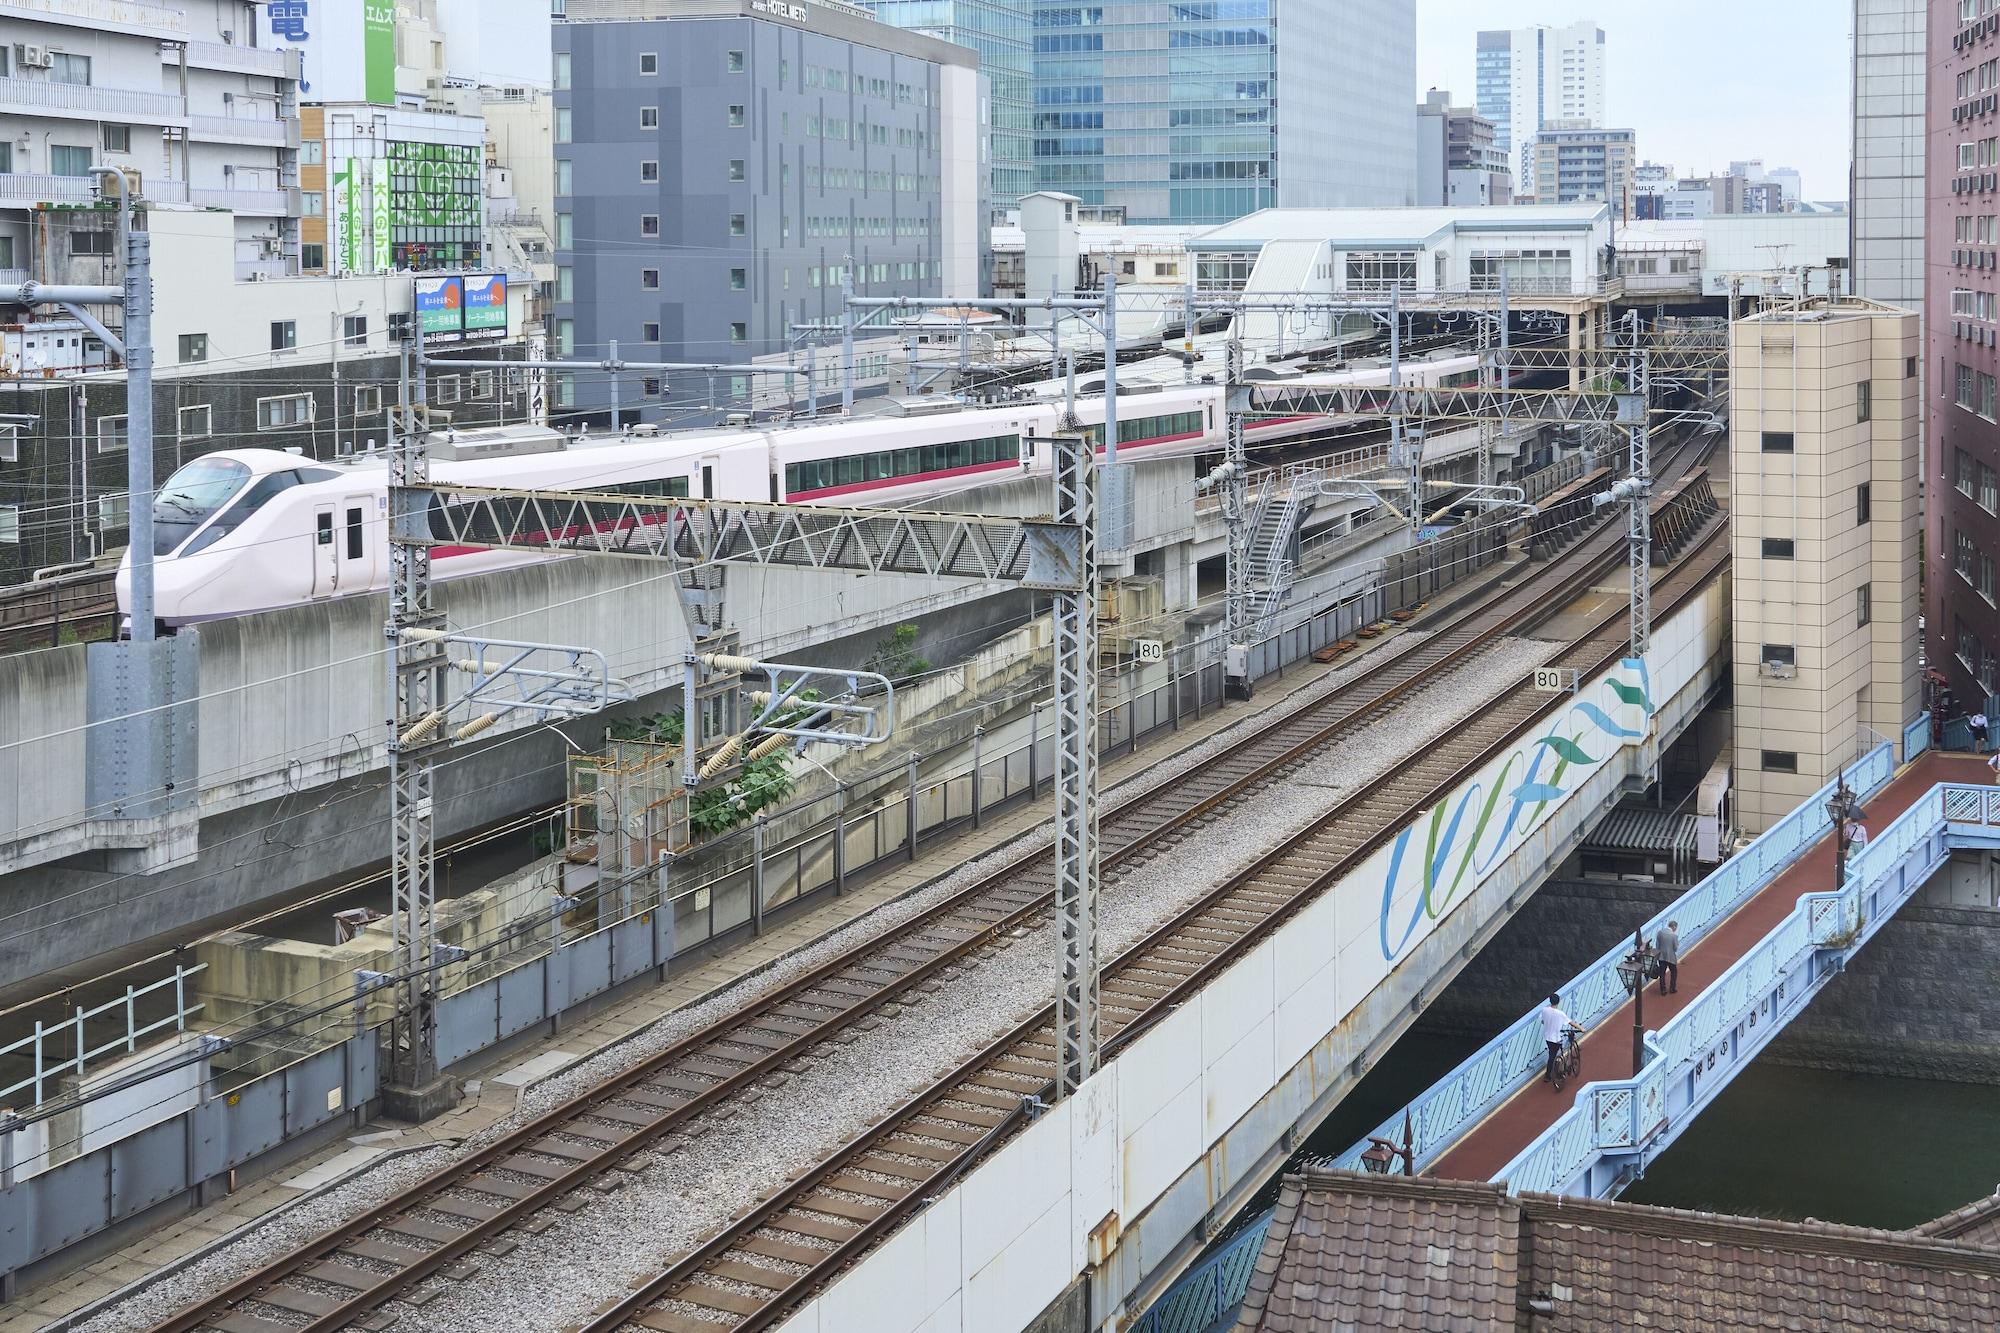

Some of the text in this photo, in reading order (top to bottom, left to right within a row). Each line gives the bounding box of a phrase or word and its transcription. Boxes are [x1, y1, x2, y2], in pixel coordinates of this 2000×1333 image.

[767, 0, 789, 17] HOTEL
[789, 4, 806, 22] METS
[1143, 644, 1160, 658] 80
[1538, 672, 1557, 687] 80
